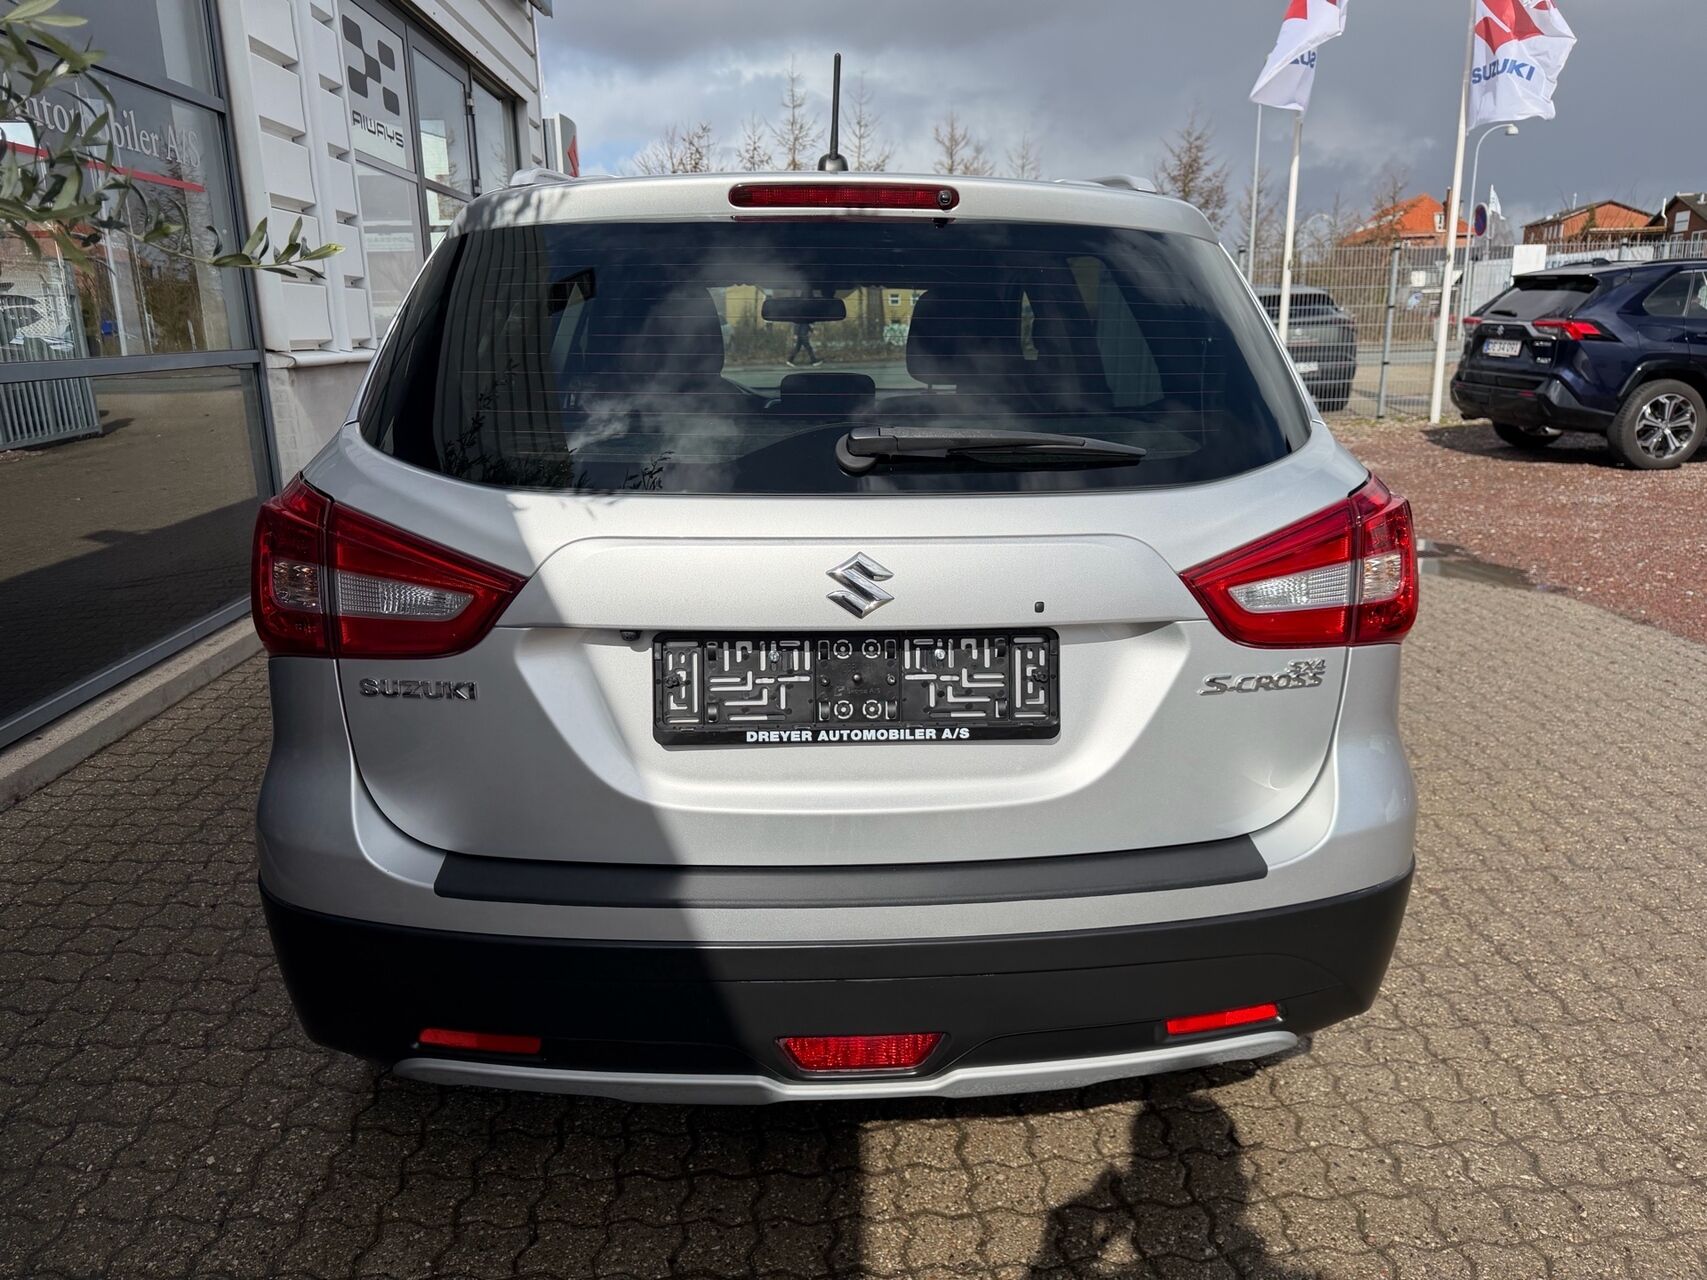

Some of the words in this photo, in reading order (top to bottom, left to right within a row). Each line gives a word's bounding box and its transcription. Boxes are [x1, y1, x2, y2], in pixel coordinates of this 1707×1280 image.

[1472, 58, 1535, 84] SUZUKI
[352, 111, 404, 149] AIWAYS
[166, 125, 202, 168] A/S
[1285, 657, 1326, 673] SX4
[360, 679, 478, 700] SUZUKI
[1197, 671, 1325, 695] S-CROSS
[746, 730, 812, 743] DREYER
[817, 729, 936, 742] AUTOMOBILER
[941, 727, 970, 740] A/S
